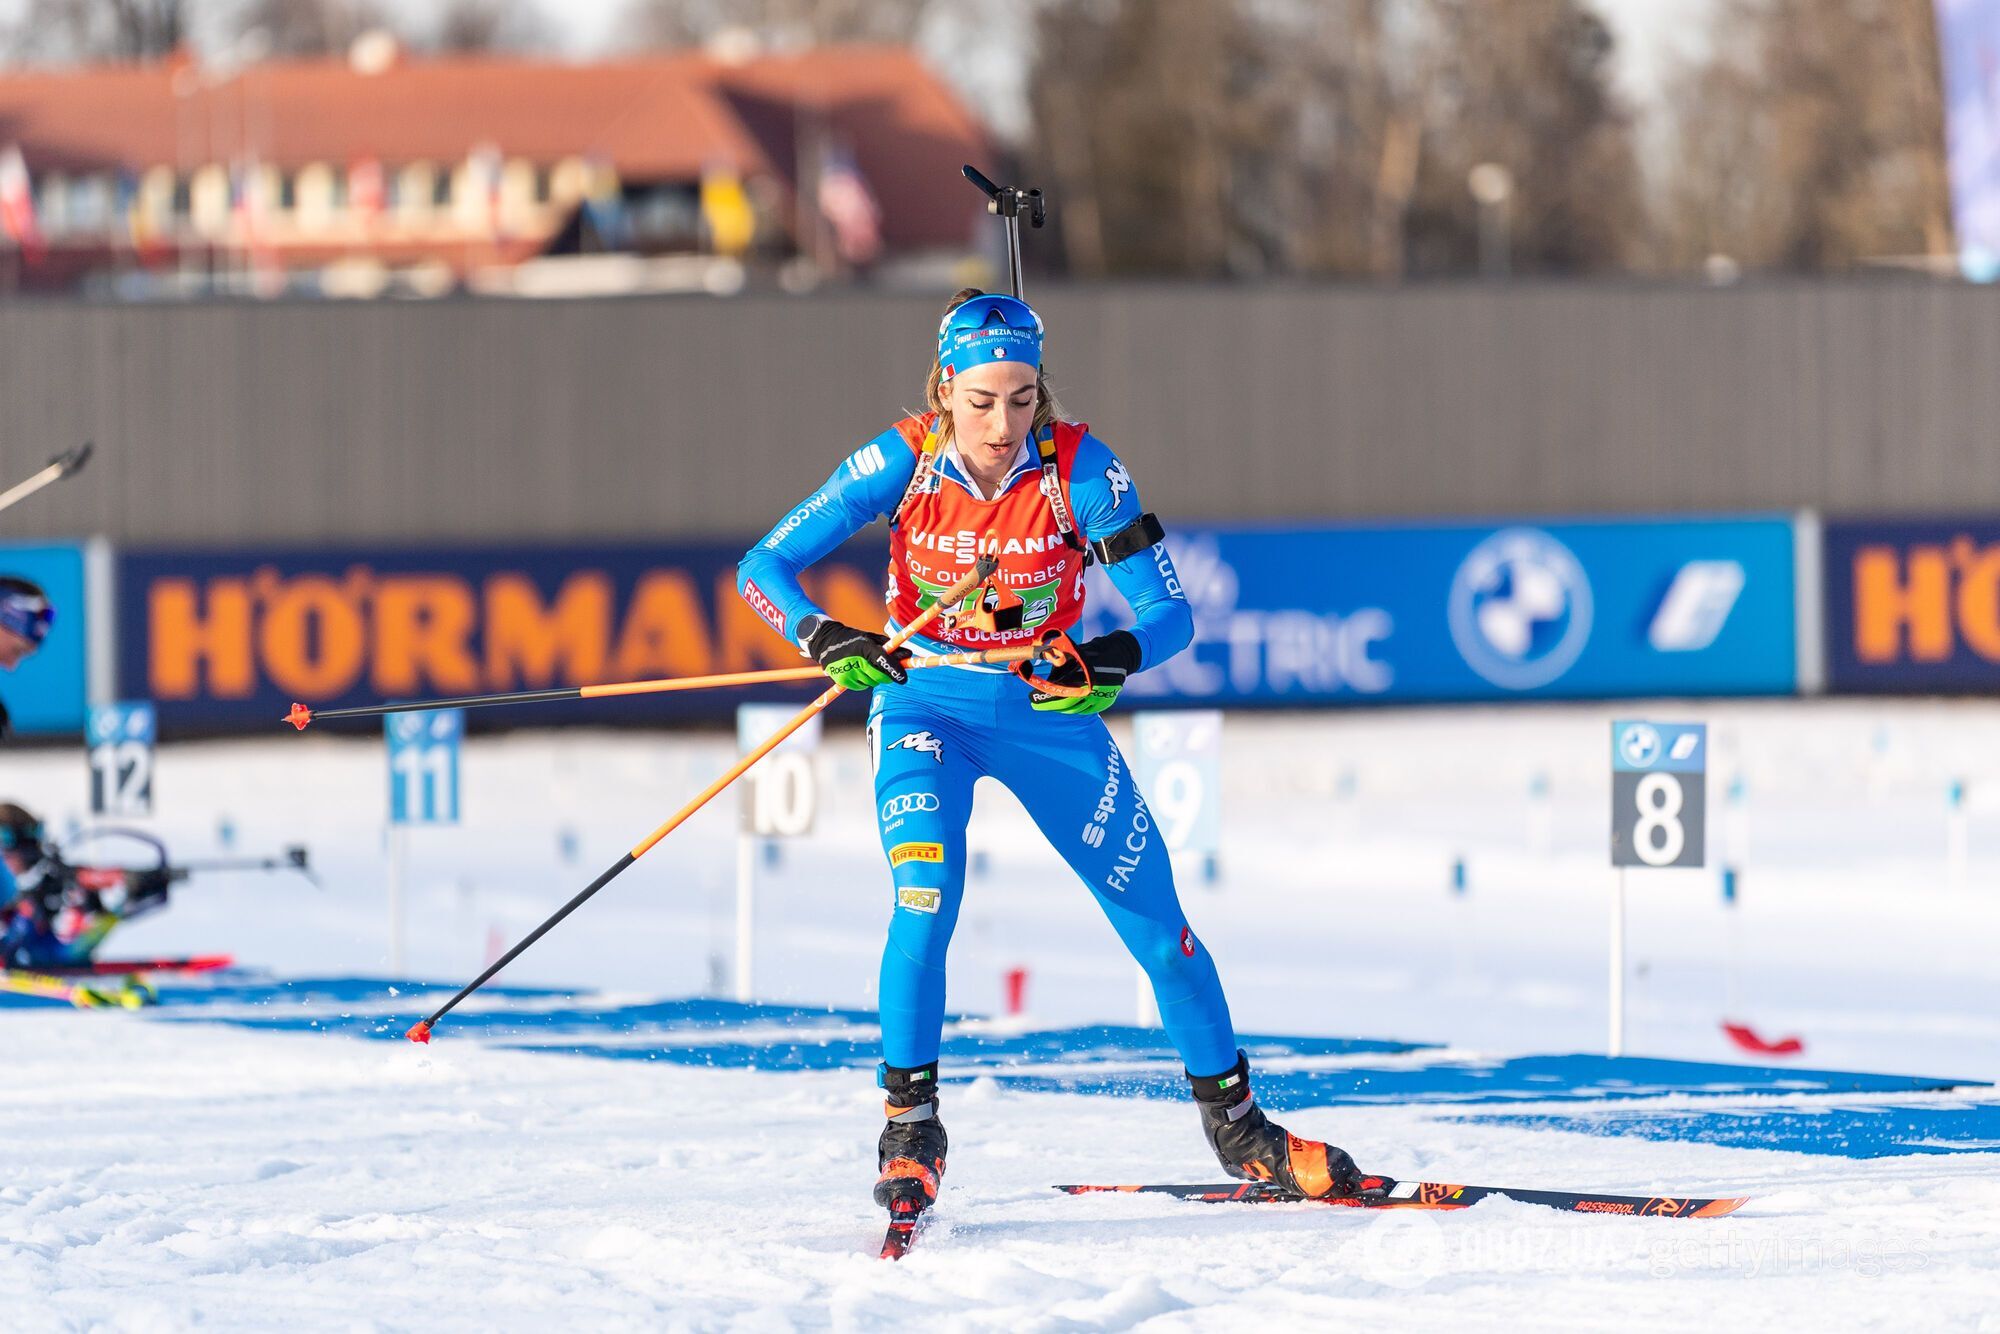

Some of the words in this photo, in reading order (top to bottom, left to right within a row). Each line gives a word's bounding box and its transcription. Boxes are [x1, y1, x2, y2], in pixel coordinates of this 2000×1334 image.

[980, 328, 1012, 337] VENEZIA
[764, 492, 828, 549] FALCONERI
[936, 570, 967, 583] ou
[997, 559, 1067, 586] limate
[744, 583, 785, 633] FIOCCHI
[92, 742, 151, 816] 12
[395, 748, 452, 818] 11
[742, 753, 813, 835] 10
[1093, 740, 1121, 825] sportful
[1154, 760, 1204, 848] 9
[884, 817, 904, 834] Audi
[1632, 772, 1684, 866] 8
[892, 846, 938, 863] PIRELLI
[1574, 1200, 1635, 1214] ROSSIGNOL
